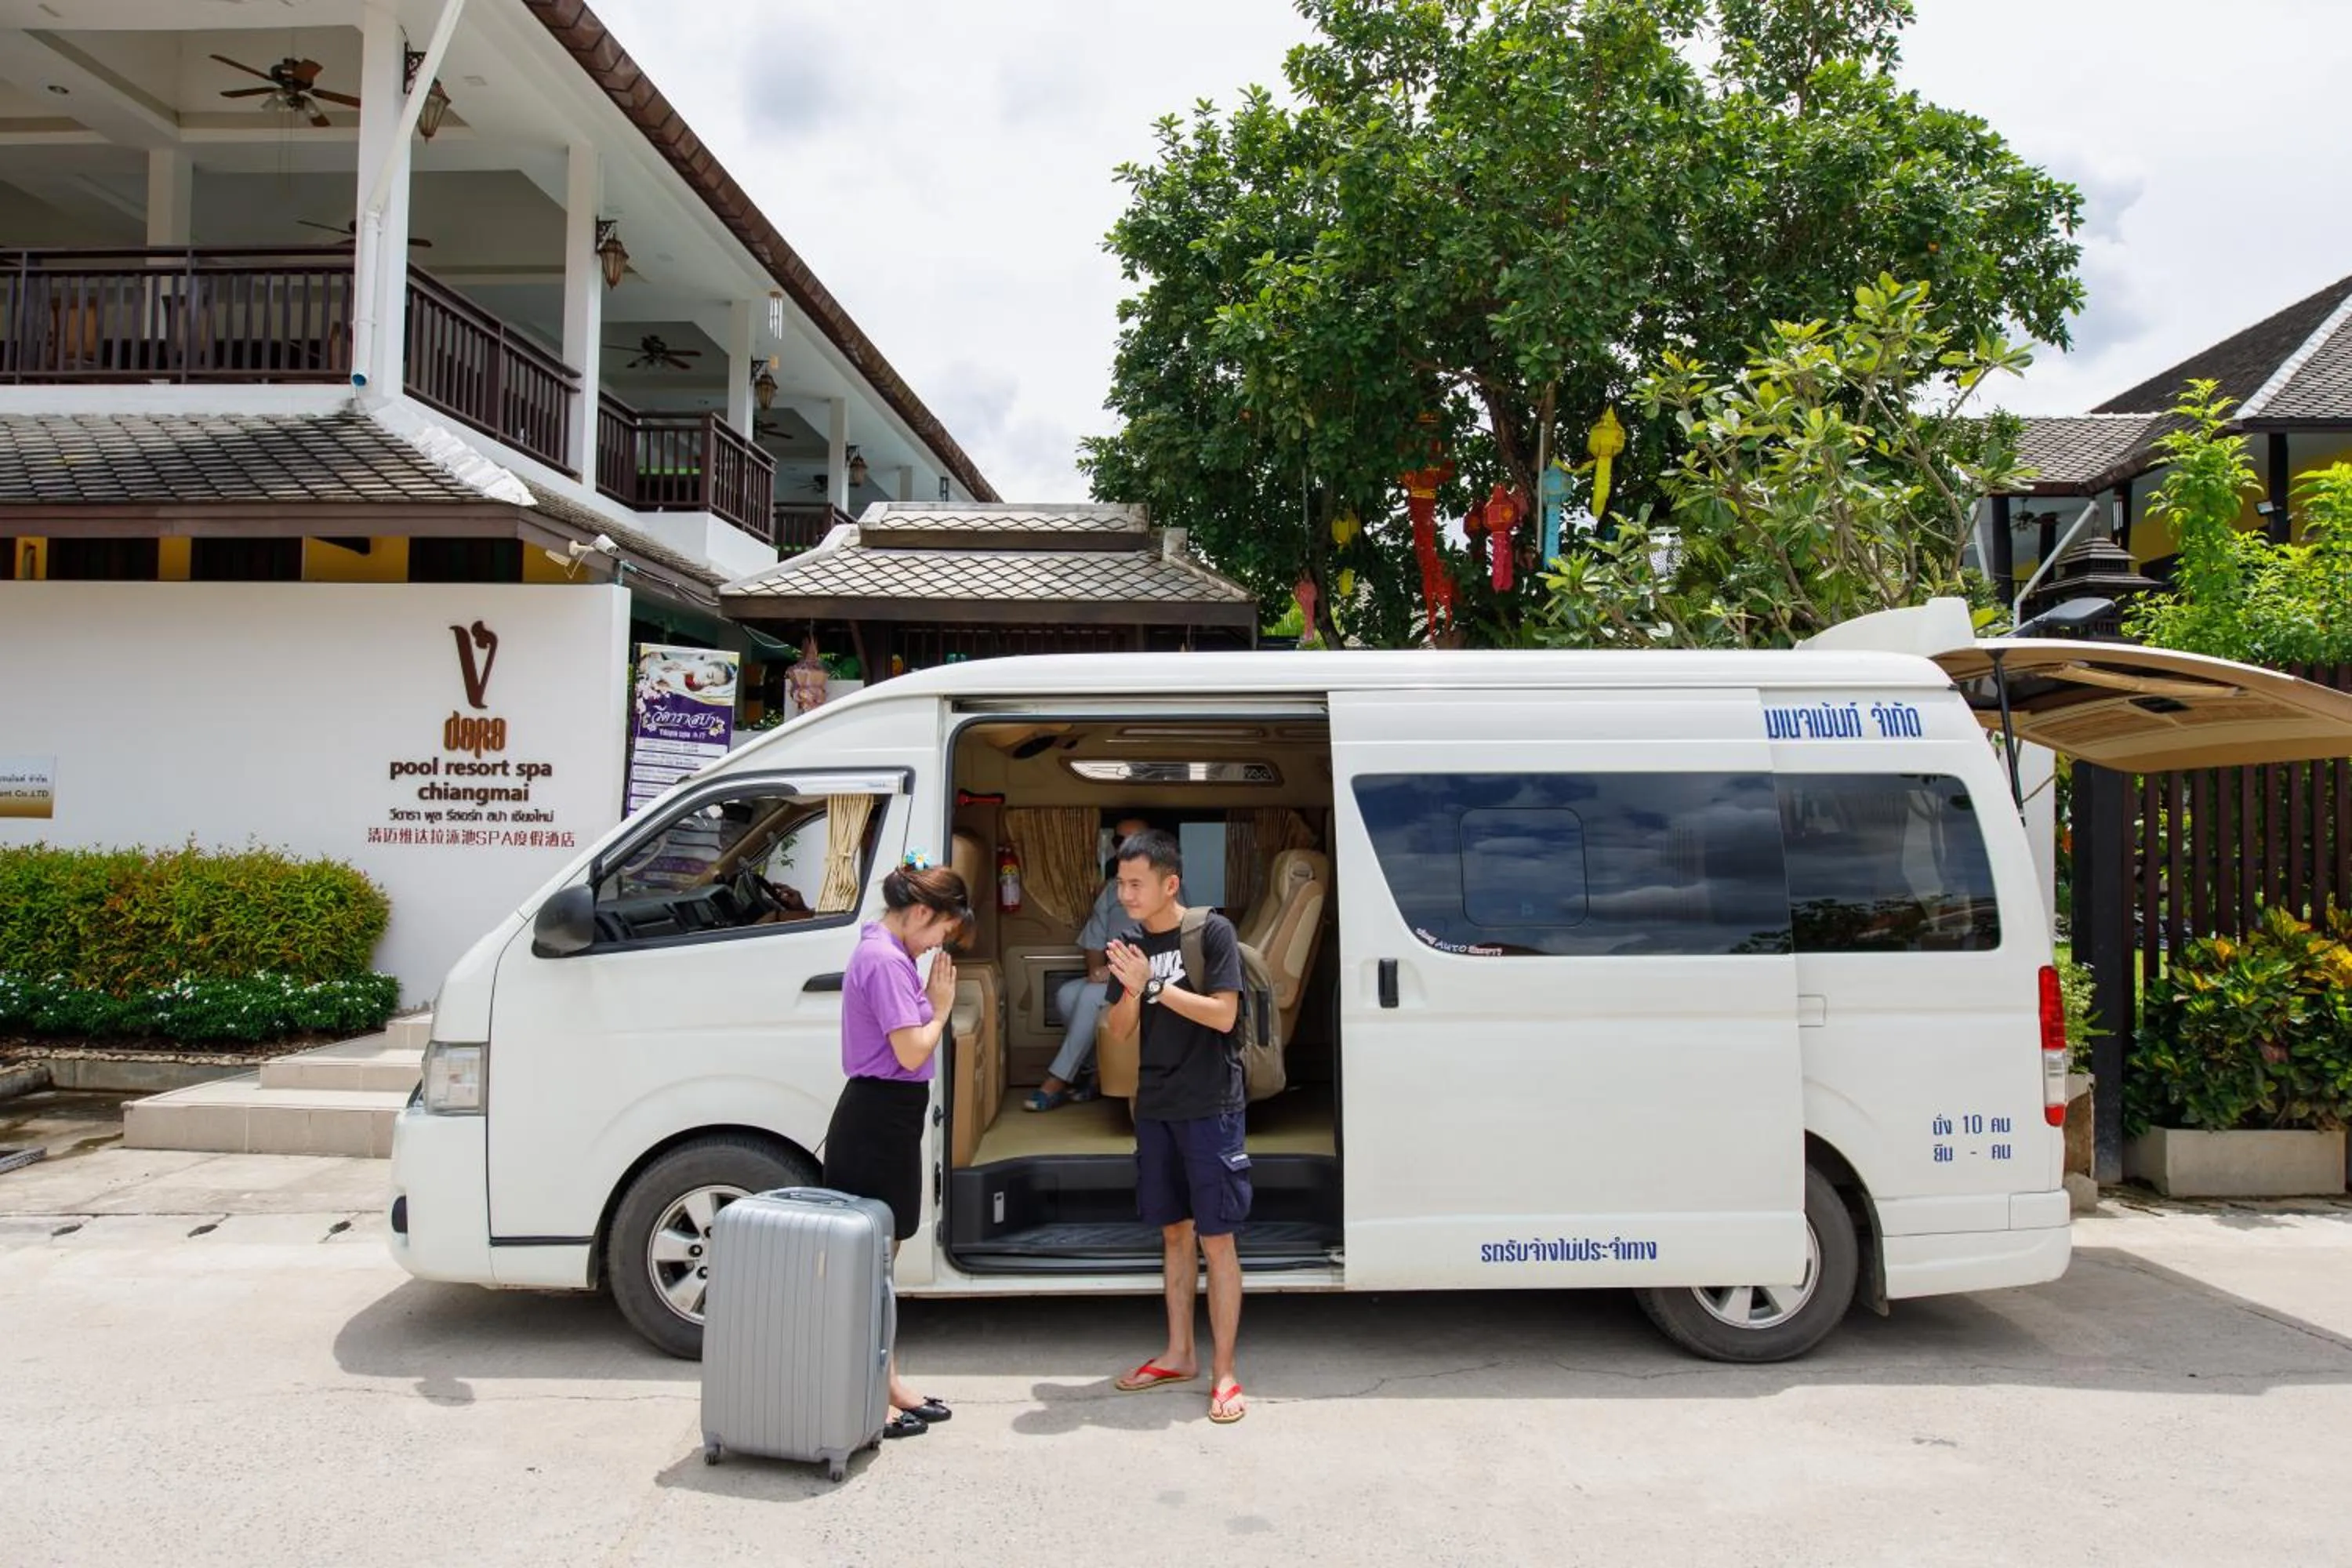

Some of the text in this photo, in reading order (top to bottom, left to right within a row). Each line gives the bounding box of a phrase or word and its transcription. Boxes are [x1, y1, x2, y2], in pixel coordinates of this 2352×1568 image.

[1871, 701, 1922, 738] จำกัด
[390, 757, 553, 782] pool resort spa
[418, 782, 530, 806] chiangmai
[486, 810, 507, 822] สปา
[1932, 1113, 2010, 1135] นั่ง 10 คน
[1933, 1144, 1953, 1162] ยืน
[1991, 1144, 2011, 1160] คน
[1480, 1236, 1657, 1262] รถรับจ้างไม่ประจำทาง
